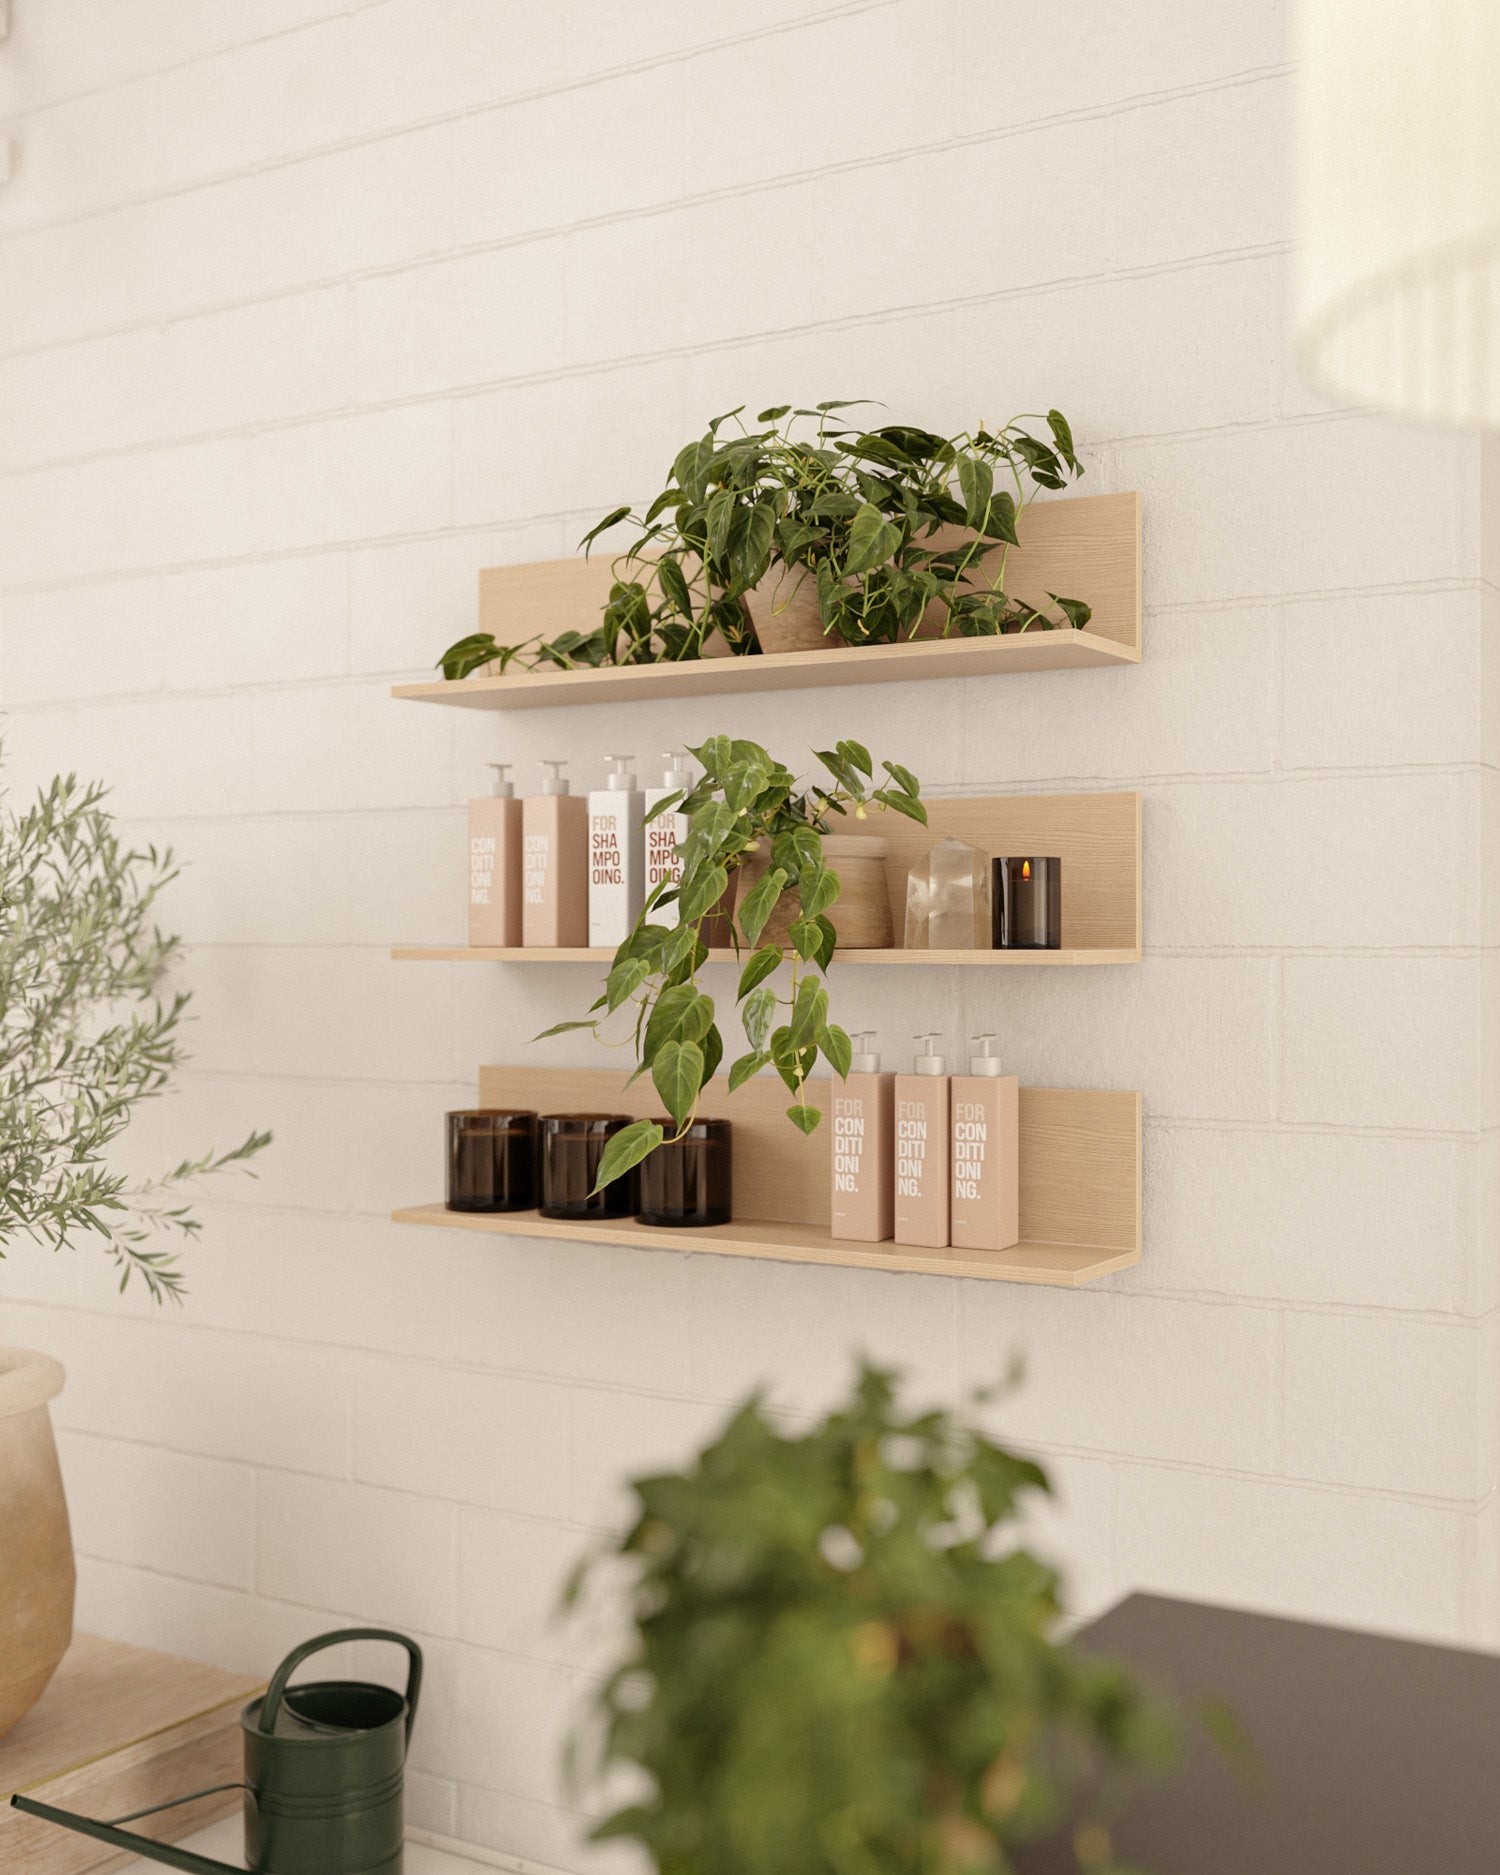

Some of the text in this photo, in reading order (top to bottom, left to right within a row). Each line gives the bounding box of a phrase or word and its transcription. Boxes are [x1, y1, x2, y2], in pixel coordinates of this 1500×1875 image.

[593, 815, 616, 831] FOR
[592, 833, 617, 849] SHA
[650, 832, 677, 847] SHA
[593, 850, 620, 867] MPO
[592, 868, 624, 885] OING.
[835, 1098, 863, 1117] FOR
[898, 1101, 926, 1120] FOR
[955, 1103, 985, 1122] FOR
[835, 1117, 864, 1136] CON
[898, 1120, 927, 1139] CON
[955, 1121, 987, 1142] CON
[835, 1135, 863, 1155] DITI
[898, 1139, 925, 1159] DITI
[955, 1141, 985, 1161] DITI
[835, 1154, 860, 1174] ONI
[898, 1158, 922, 1178] ONI
[955, 1160, 982, 1180] ONI
[835, 1173, 859, 1193] NG.
[898, 1177, 922, 1197] NG.
[955, 1179, 981, 1200] NG.
